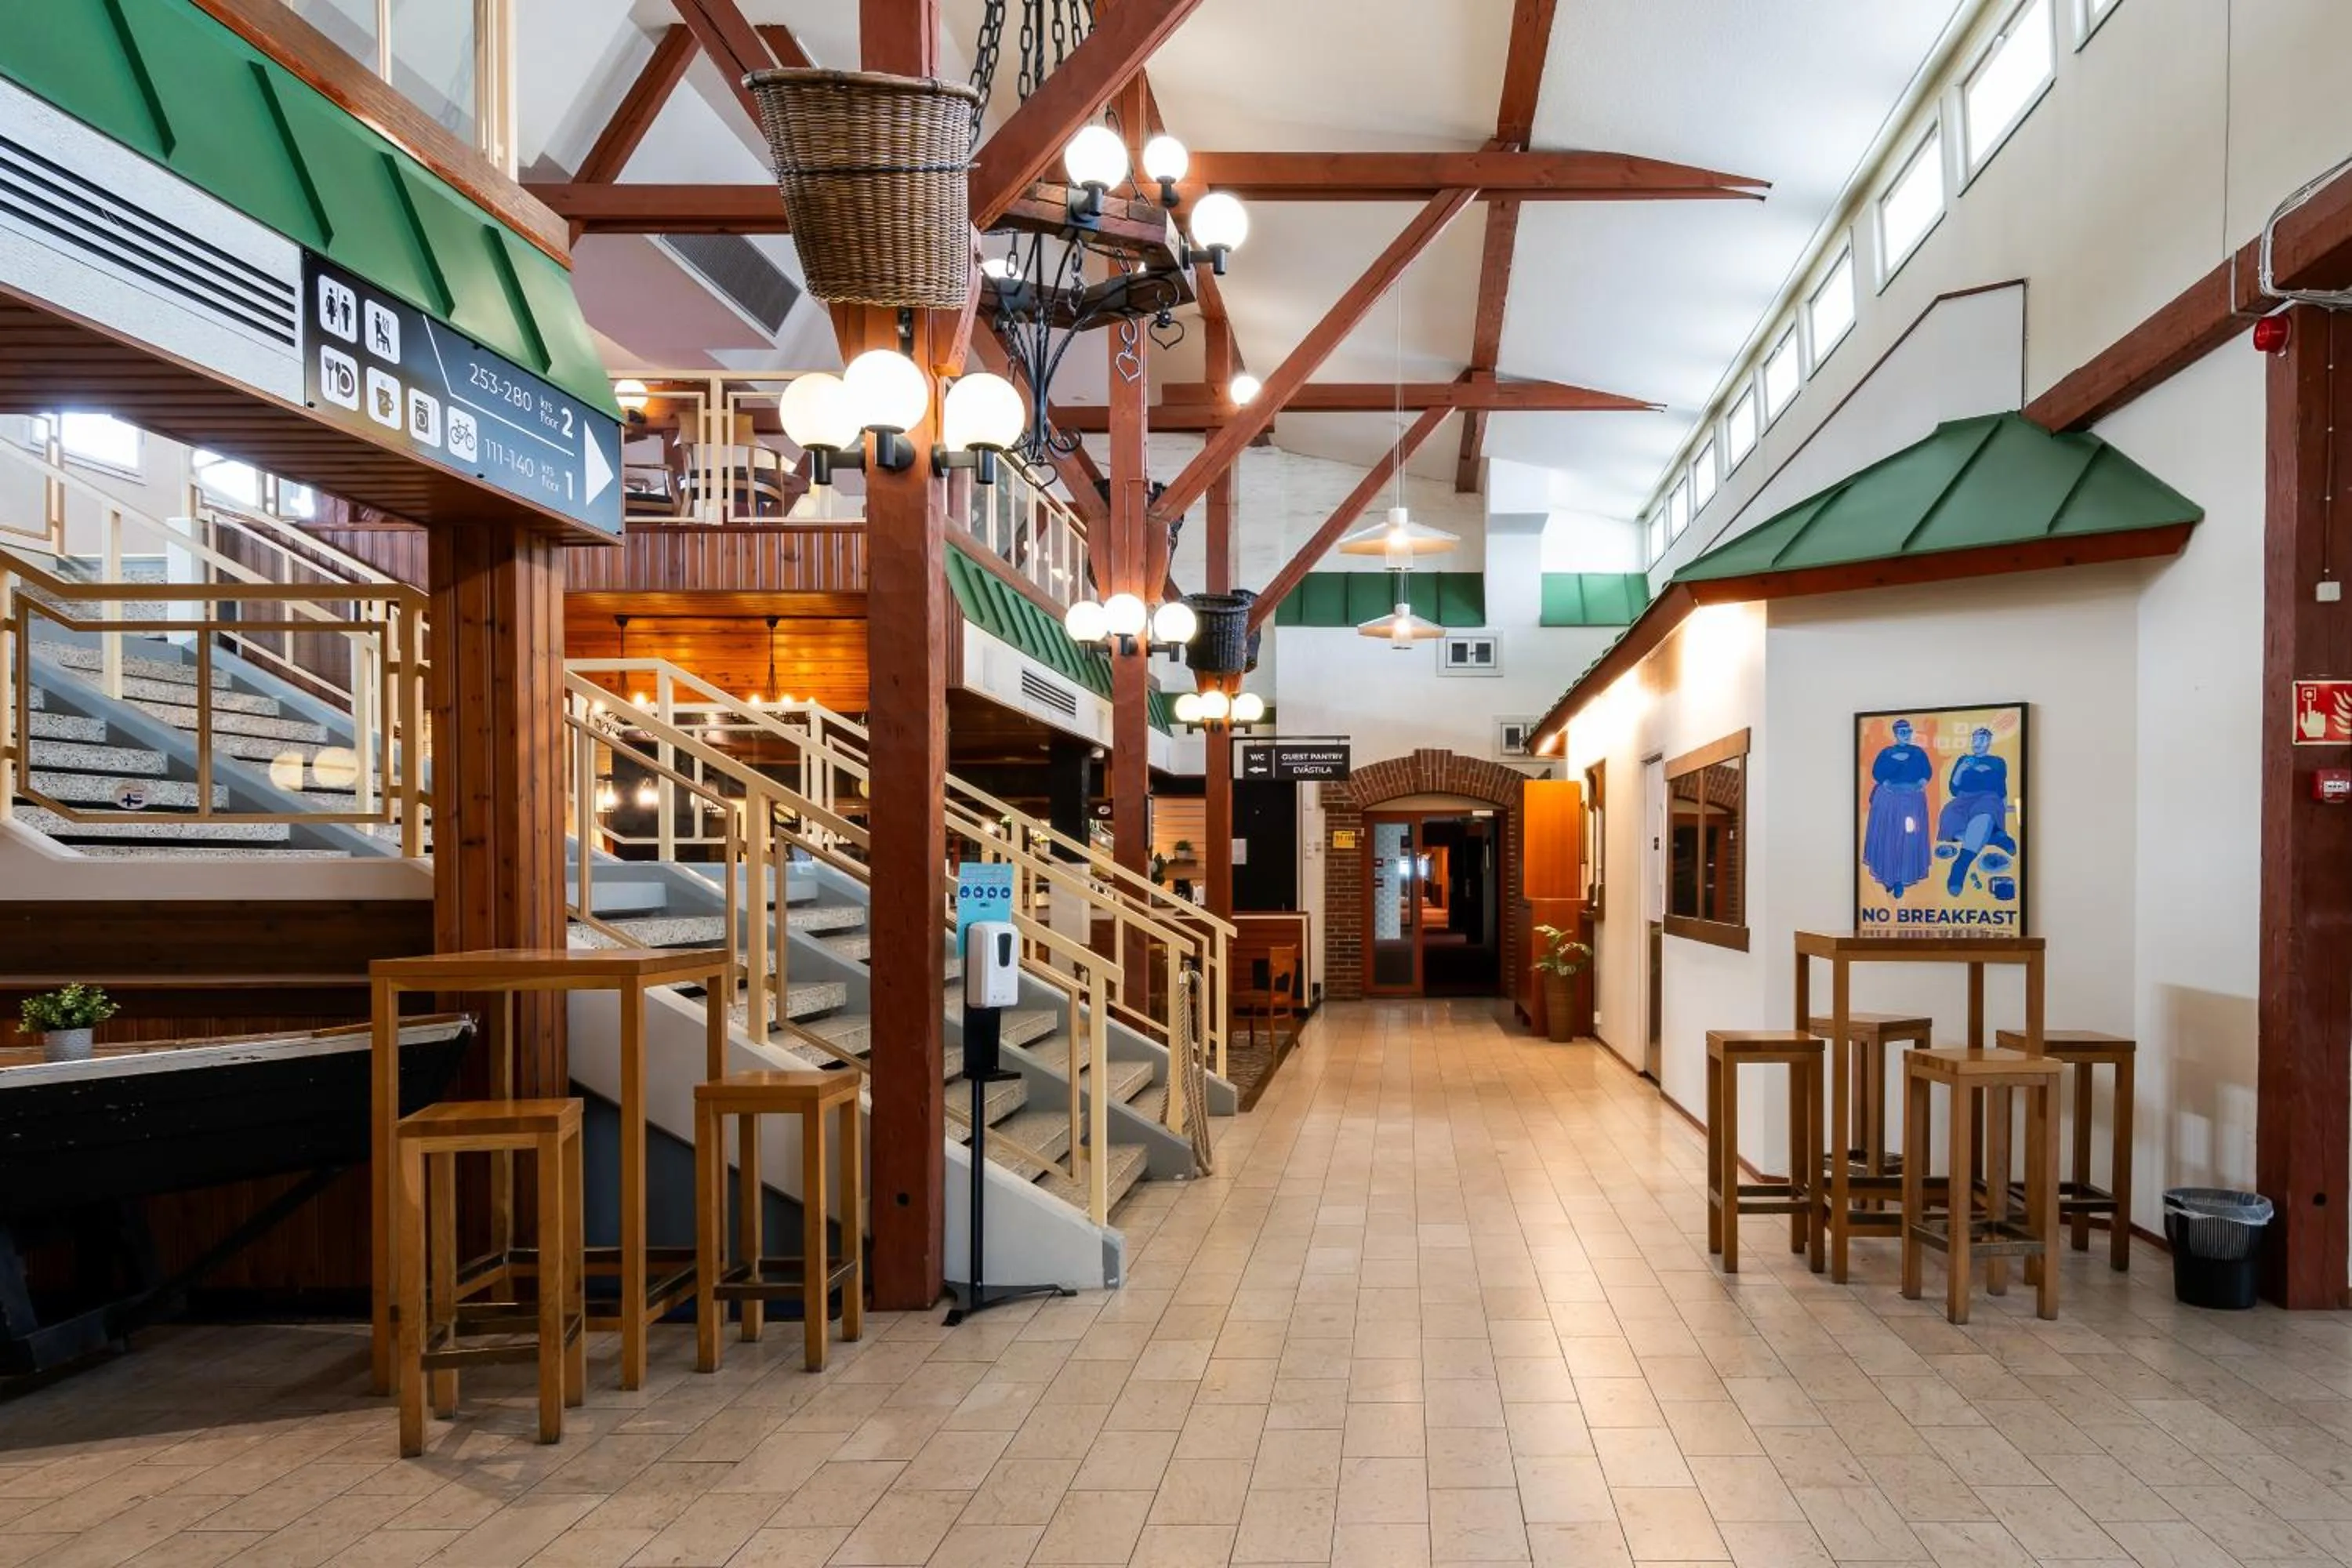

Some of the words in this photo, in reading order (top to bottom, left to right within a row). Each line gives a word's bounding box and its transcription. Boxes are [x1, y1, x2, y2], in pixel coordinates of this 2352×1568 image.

[470, 363, 532, 412] 253-280
[561, 407, 573, 439] 2
[485, 438, 534, 477] 111-140
[565, 470, 573, 501] 1
[1862, 908, 1890, 922] NO
[1896, 909, 2017, 924] BREAKFAST
